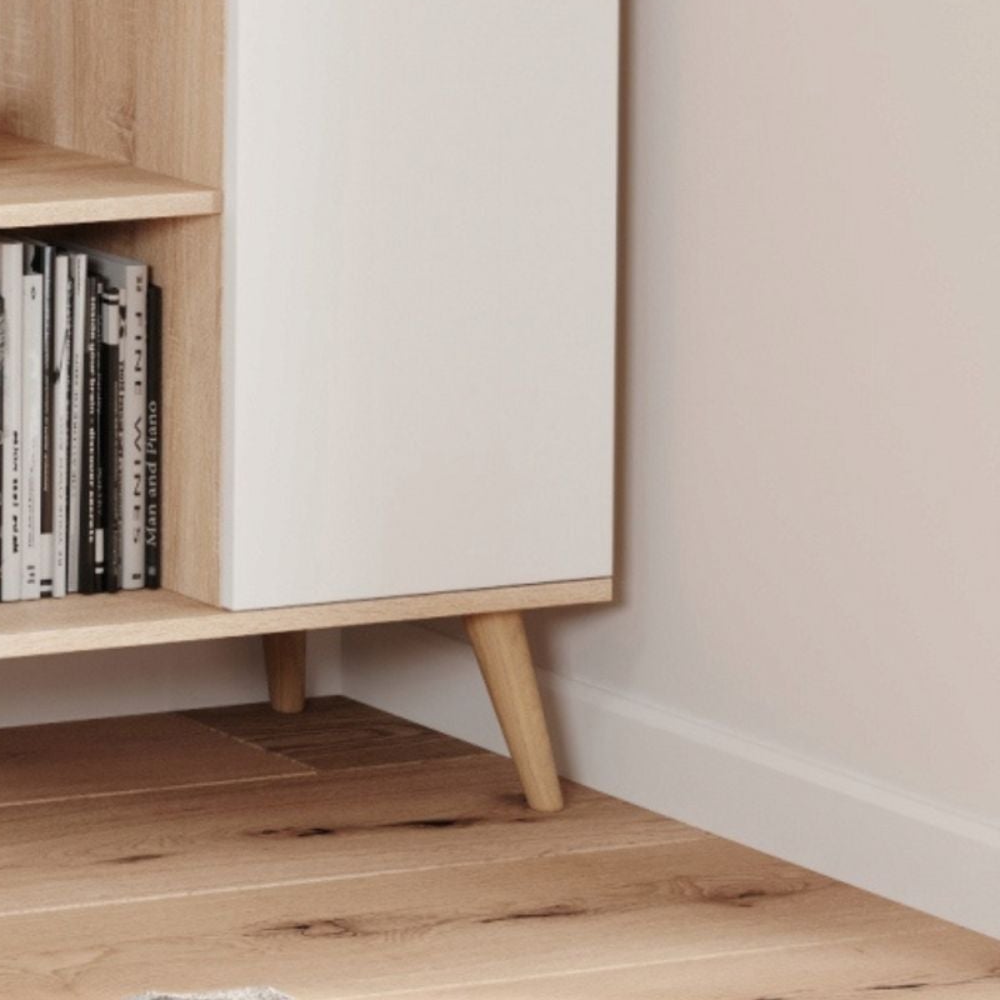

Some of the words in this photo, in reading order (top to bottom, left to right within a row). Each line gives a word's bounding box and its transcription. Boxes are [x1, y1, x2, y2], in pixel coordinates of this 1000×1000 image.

[134, 311, 143, 396] FINE
[146, 400, 158, 455] Piano
[132, 416, 143, 545] WINES
[146, 462, 157, 498] and
[145, 504, 157, 547] Man
